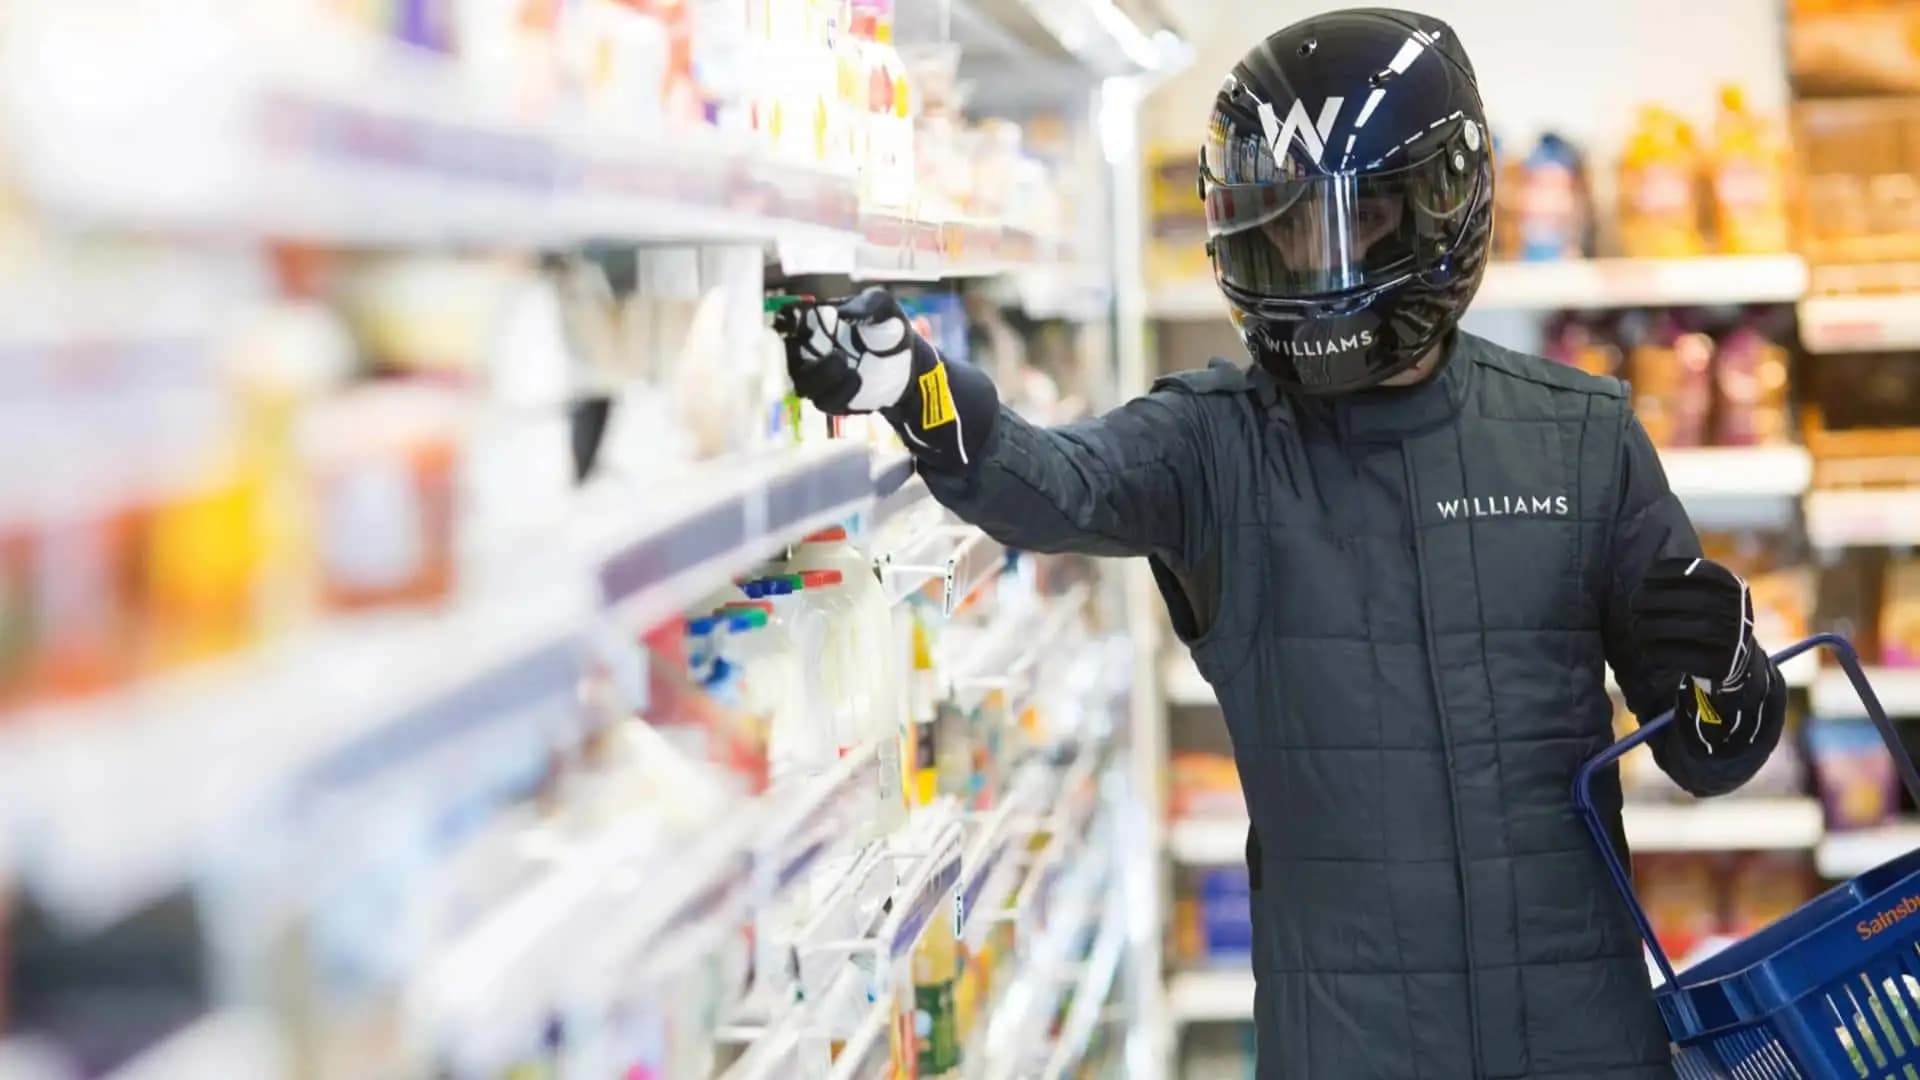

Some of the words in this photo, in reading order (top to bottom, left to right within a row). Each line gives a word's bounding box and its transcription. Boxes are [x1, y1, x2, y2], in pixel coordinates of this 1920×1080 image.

[1257, 96, 1344, 169] W
[1265, 330, 1373, 356] WILLIAMS
[1436, 496, 1569, 519] WILLIAMS
